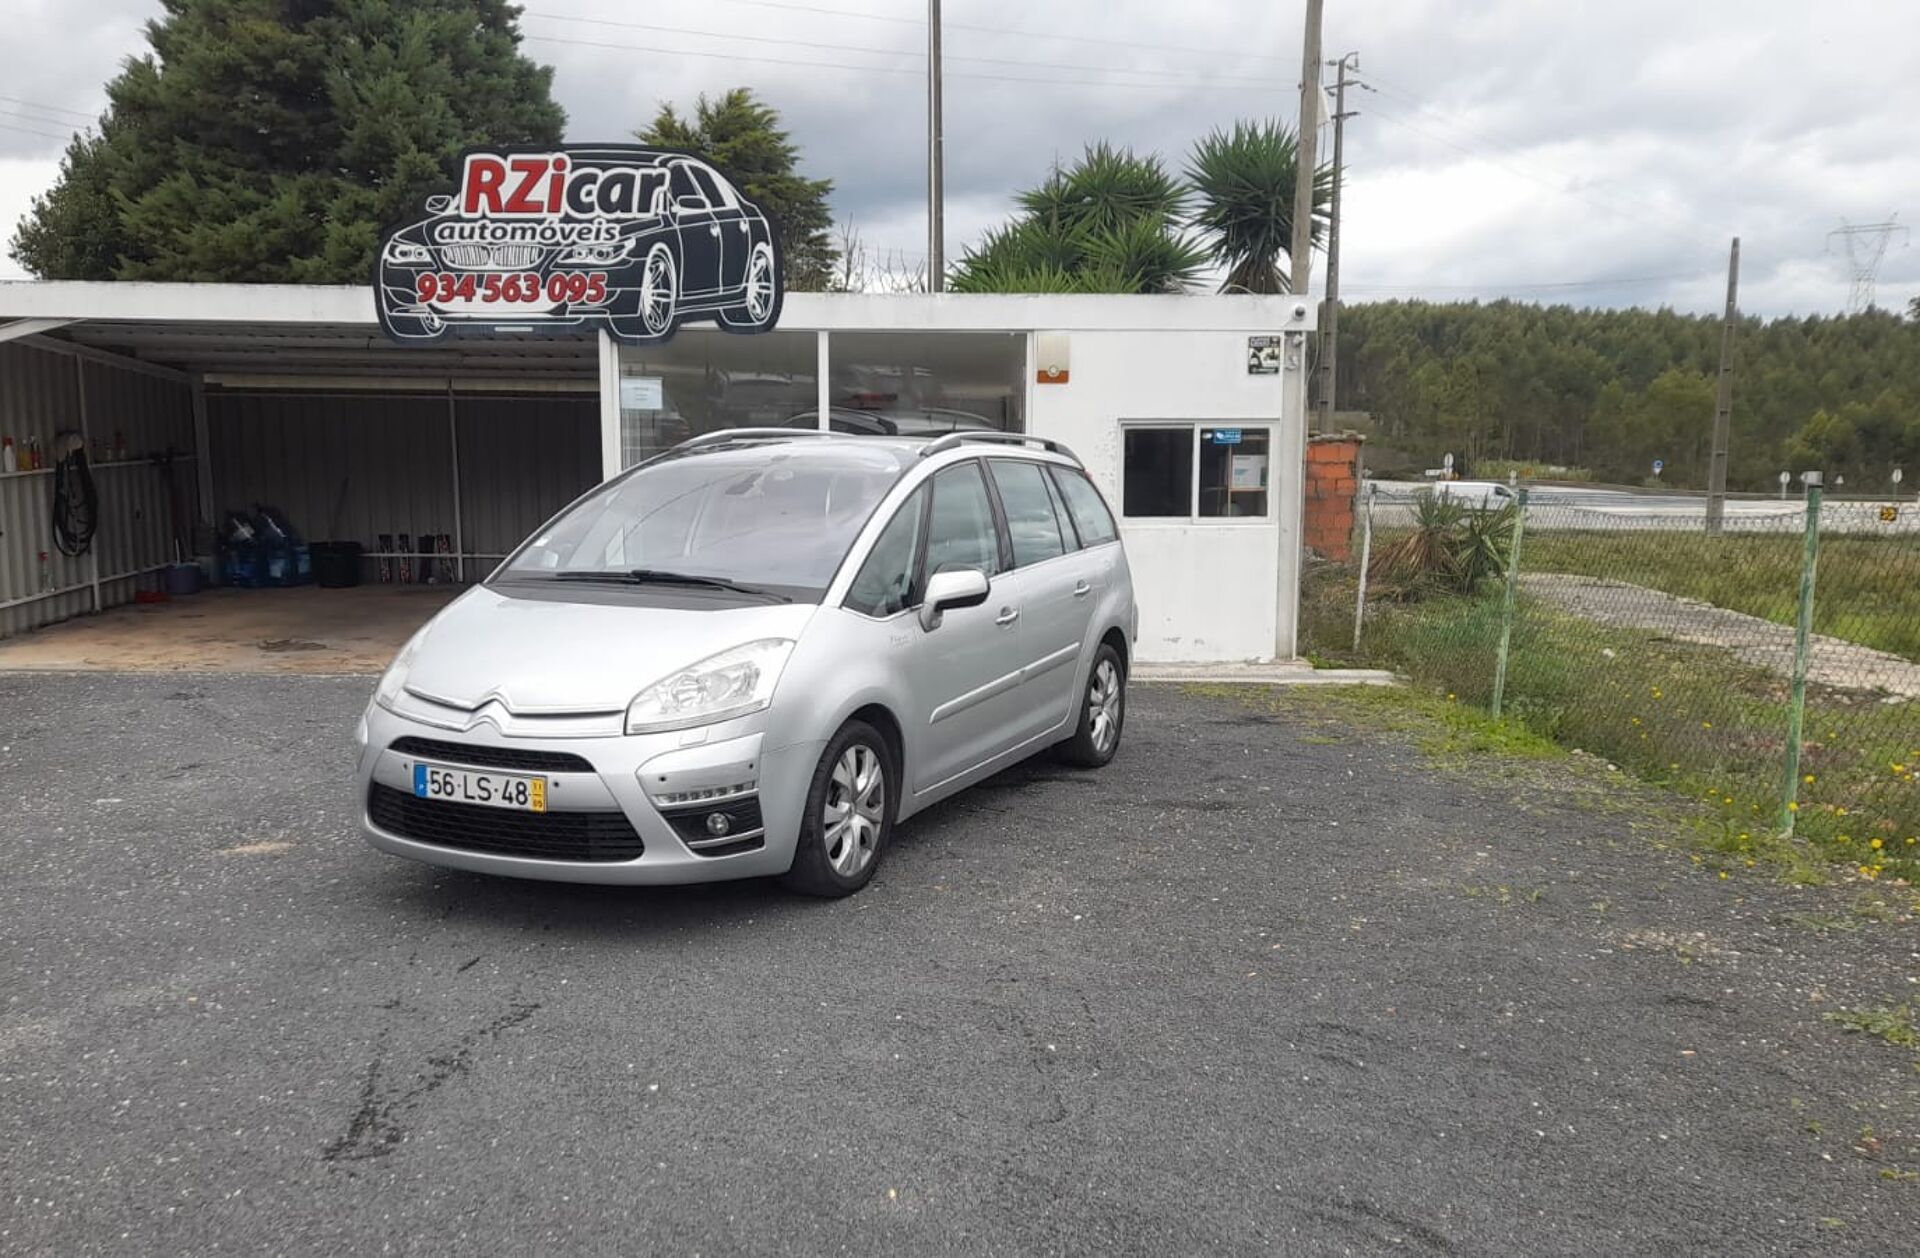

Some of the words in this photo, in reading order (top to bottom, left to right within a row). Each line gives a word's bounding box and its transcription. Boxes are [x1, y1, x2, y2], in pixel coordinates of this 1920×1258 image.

[465, 157, 668, 214] RZicar
[439, 219, 617, 241] automóveis
[417, 274, 475, 303] 934
[483, 273, 541, 303] 563
[547, 273, 607, 303] 095
